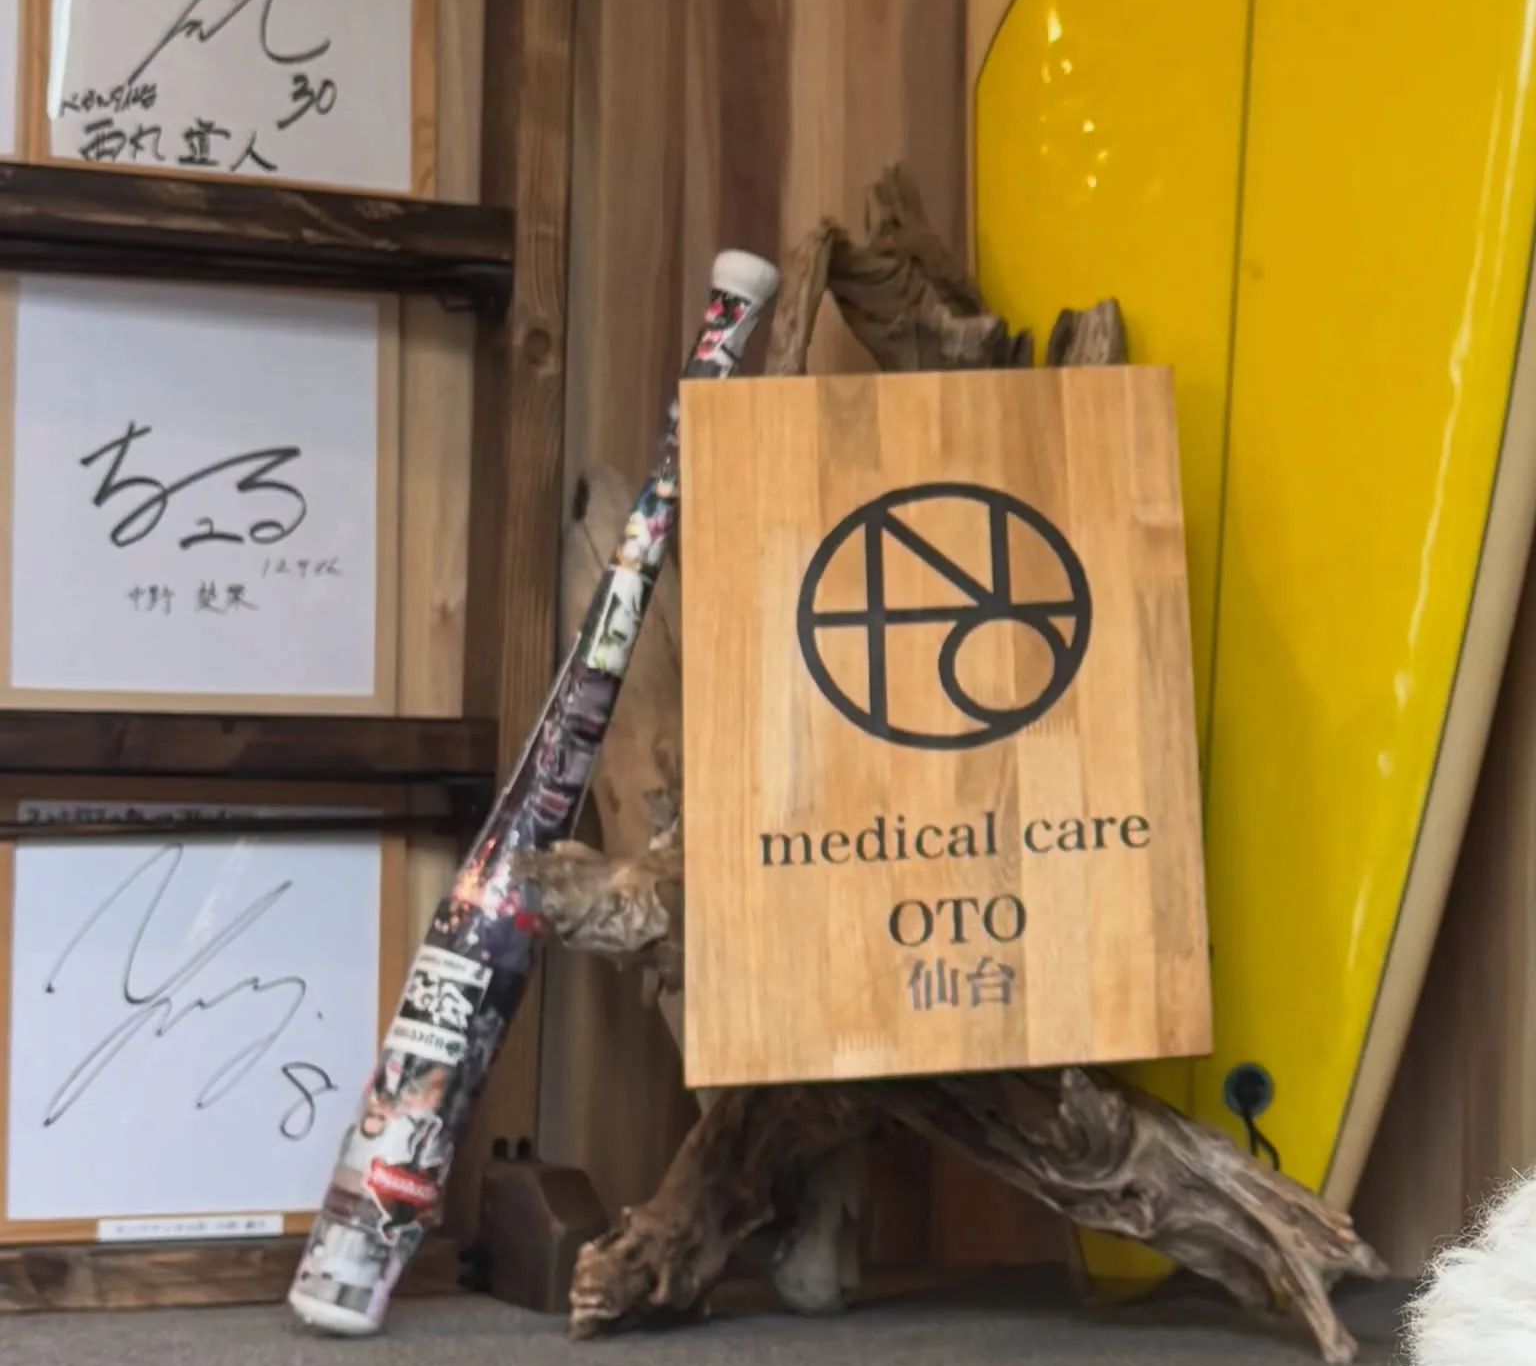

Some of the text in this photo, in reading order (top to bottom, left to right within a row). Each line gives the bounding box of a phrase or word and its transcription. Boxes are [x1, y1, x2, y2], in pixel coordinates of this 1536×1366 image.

[276, 73, 337, 130] 30
[760, 809, 1152, 867] medical care
[888, 893, 1028, 947] OTO
[906, 955, 1017, 1012] 仙台
